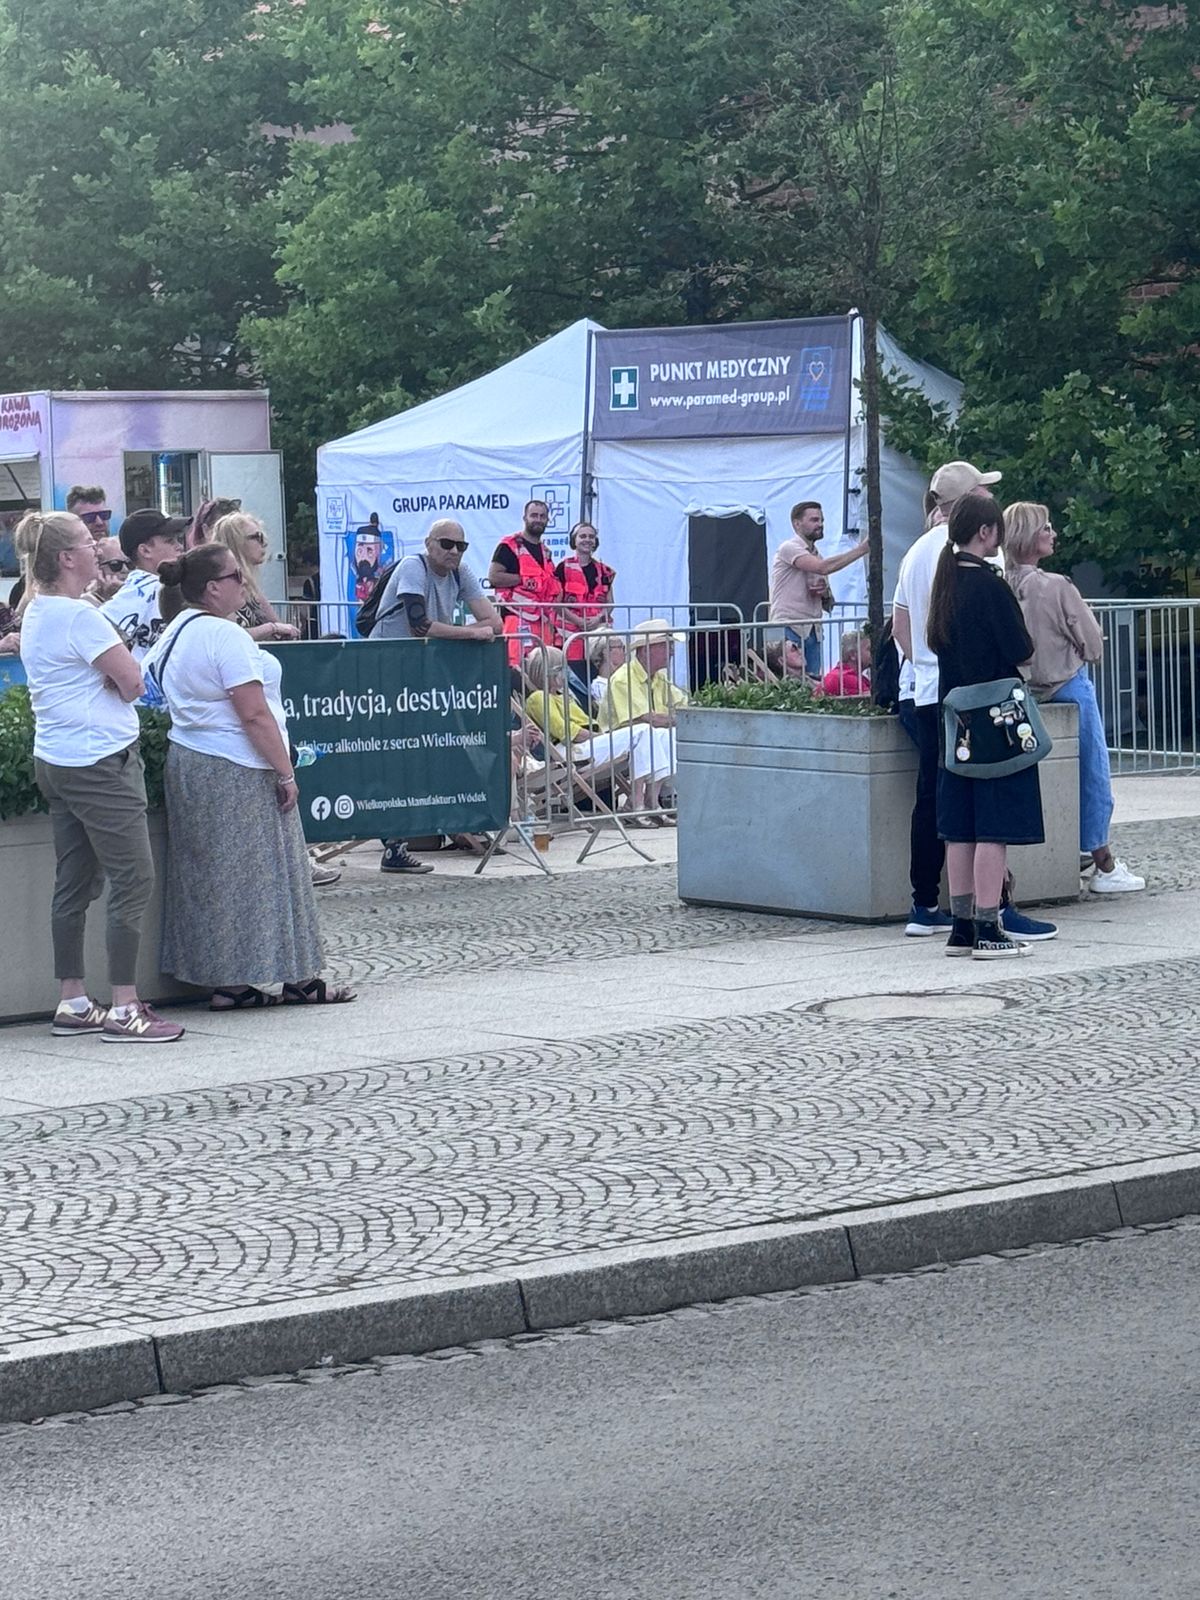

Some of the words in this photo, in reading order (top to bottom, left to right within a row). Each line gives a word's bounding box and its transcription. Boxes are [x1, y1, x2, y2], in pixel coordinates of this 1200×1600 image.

[650, 361, 702, 382] PUNKT
[706, 356, 791, 380] MEDYCZNY
[1, 396, 31, 414] KAWA
[650, 385, 791, 410] www.paramed-group.pl
[392, 495, 437, 514] GRUPA
[439, 493, 509, 511] PARAMED
[303, 687, 392, 722] tradycja,
[396, 683, 498, 717] destylacja!
[334, 736, 381, 754] alkohole
[382, 742, 389, 751] z
[389, 738, 420, 751] serca
[421, 731, 487, 749] Wielkopolski
[356, 798, 407, 811] Wielkopolska
[407, 794, 457, 807] Manufaktura
[457, 791, 487, 804] Wódek
[129, 1018, 152, 1034] N
